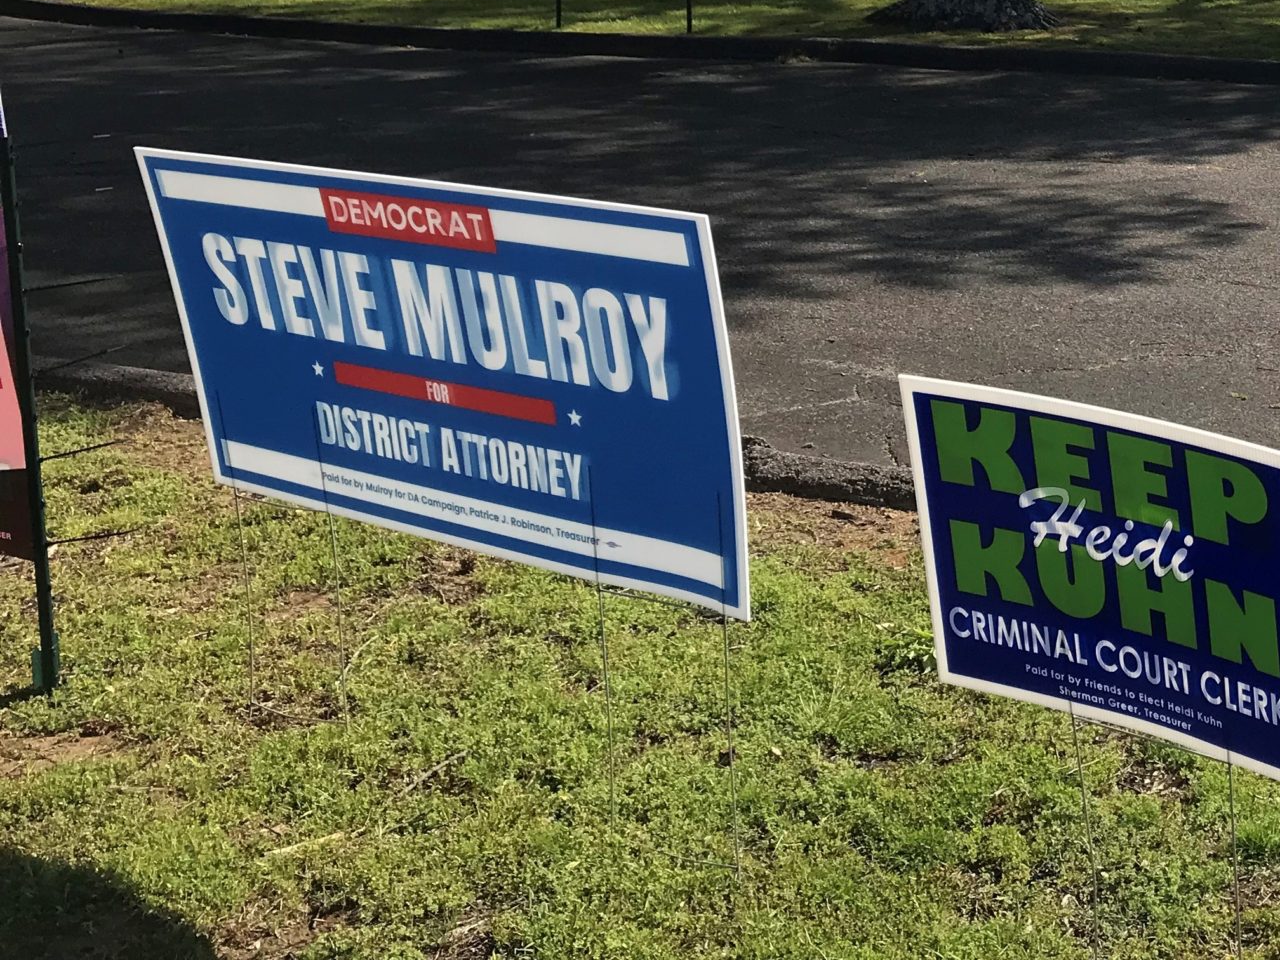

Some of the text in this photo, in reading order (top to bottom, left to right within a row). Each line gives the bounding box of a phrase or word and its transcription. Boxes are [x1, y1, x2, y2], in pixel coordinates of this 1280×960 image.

[329, 195, 485, 242] DEMOCRAT
[202, 231, 669, 401] STEVE MULROY
[425, 380, 449, 404] FOR
[316, 401, 583, 501] DISTRICT ATTORNEY
[930, 399, 1268, 546] KEEP
[322, 471, 600, 546] Paid for by Mulroy for DA Campaign, Patrice J. Robinson, Treasurer
[1019, 486, 1194, 581] Heidi
[949, 519, 1280, 678] KUHN
[949, 606, 1088, 667] CRIMINAL
[1095, 640, 1191, 695] COURT
[1025, 664, 1223, 728] Paid for by Friends to Elect Heidi Kuhn
[1059, 686, 1192, 731] Sherman Greer, Treasurer
